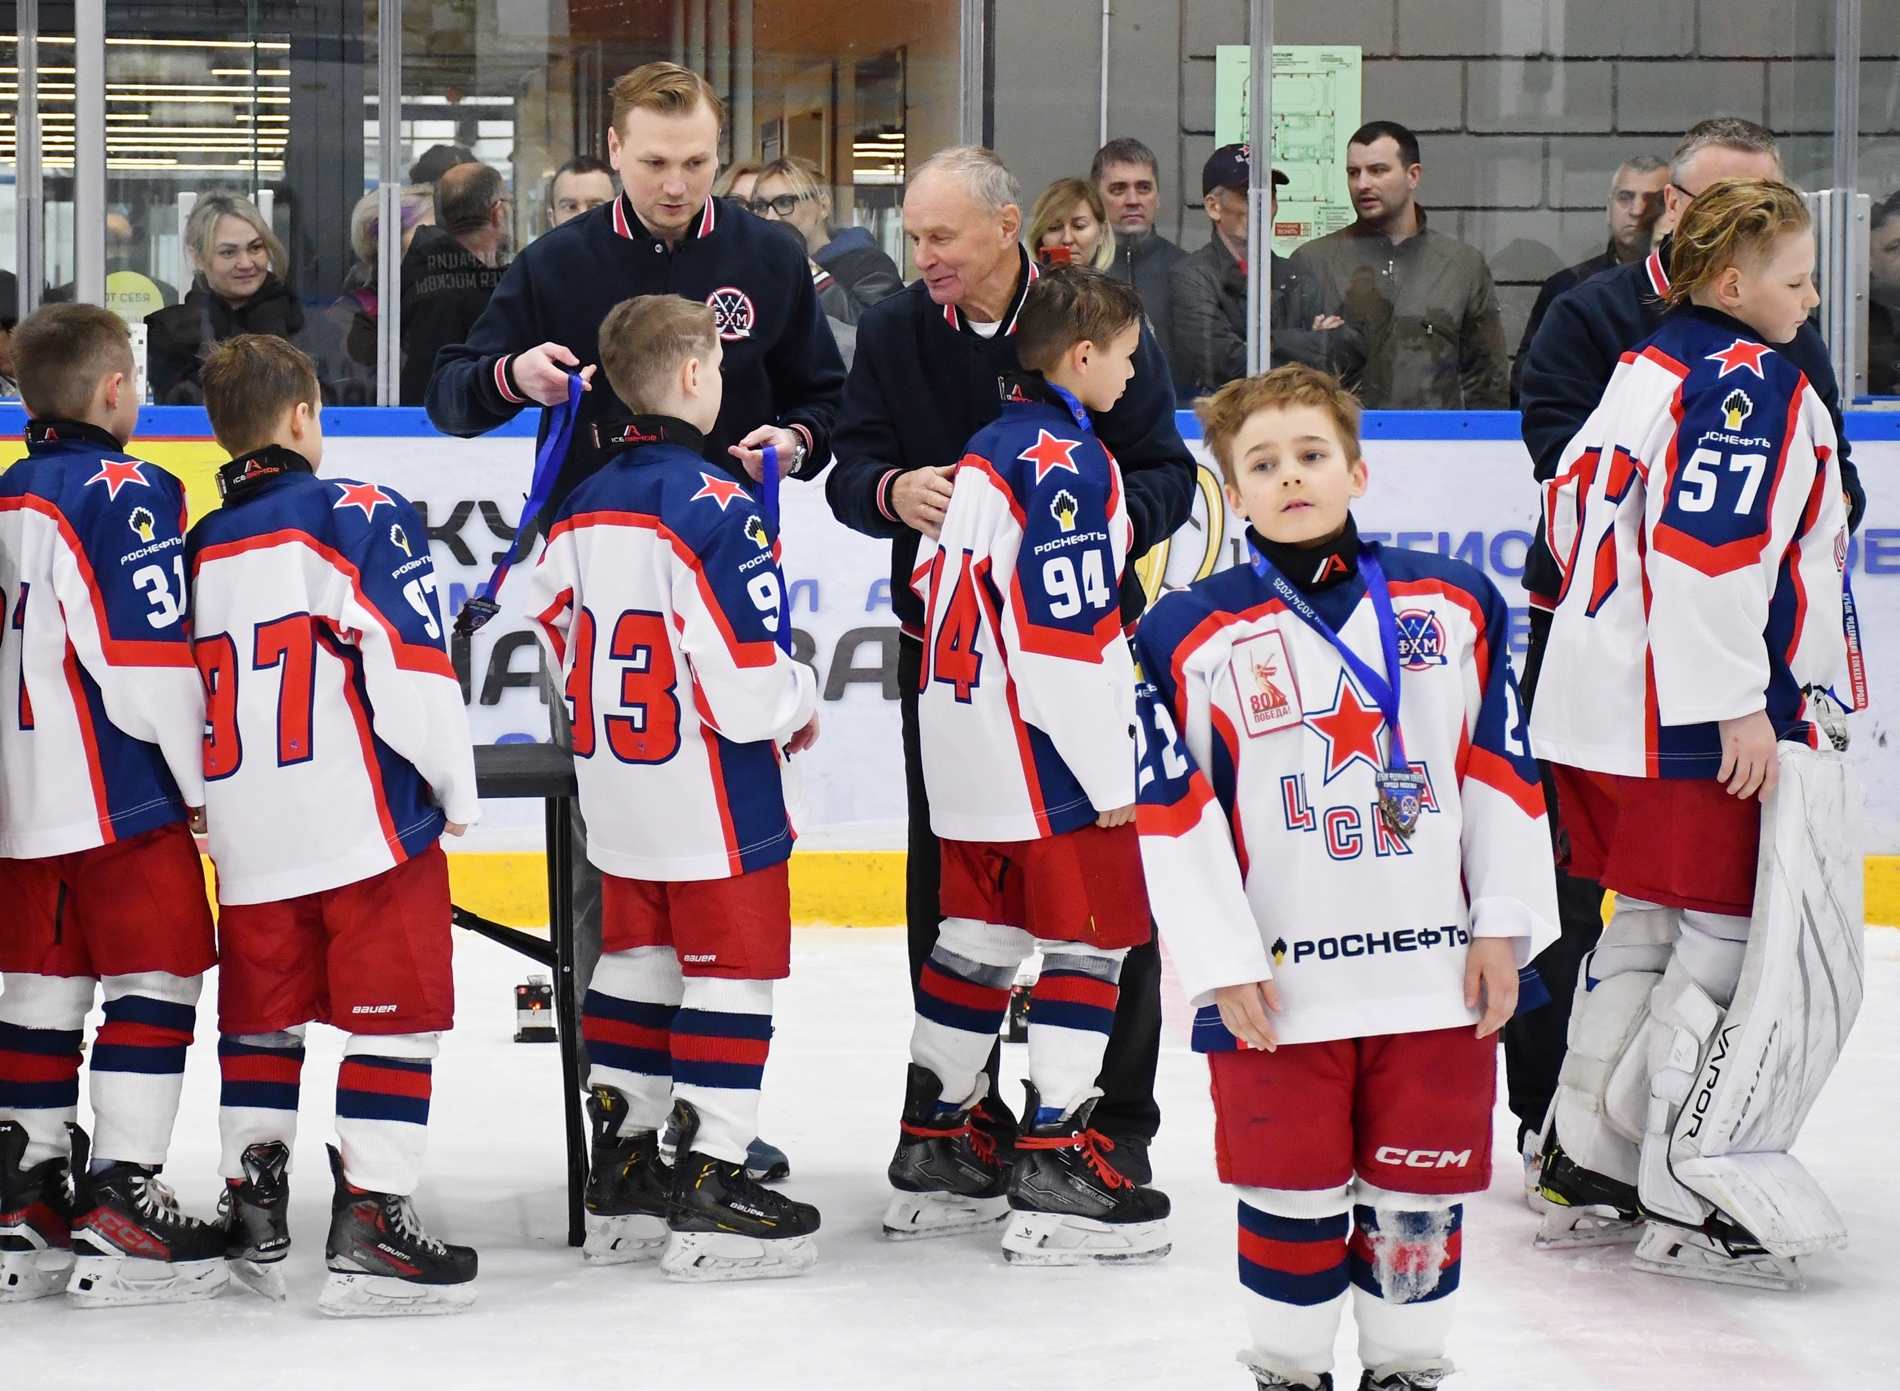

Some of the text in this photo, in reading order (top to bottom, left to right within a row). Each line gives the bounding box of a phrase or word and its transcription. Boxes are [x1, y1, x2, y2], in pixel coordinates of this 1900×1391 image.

[119, 293, 151, 303] СЕБЯ
[1698, 431, 1771, 449] СНЕФТЬ
[1678, 448, 1767, 515] 57
[120, 537, 182, 566] РОСНЕФТЬ
[1034, 532, 1107, 556] РОСНЕФТЬ
[132, 555, 187, 629] 31
[1042, 549, 1111, 619] 94
[1273, 577, 1315, 618] 2024/2025
[1397, 638, 1438, 654] ФХМ
[1250, 692, 1272, 712] 80
[1254, 706, 1291, 723] ПОБЕДА!
[1294, 925, 1469, 963] РОСНЕФТЬ
[684, 954, 716, 962] BAUER
[352, 1004, 397, 1014] BAUER
[1677, 1023, 1741, 1142] VAPOR
[1375, 1146, 1472, 1170] CCM
[730, 1202, 765, 1217] BAUER
